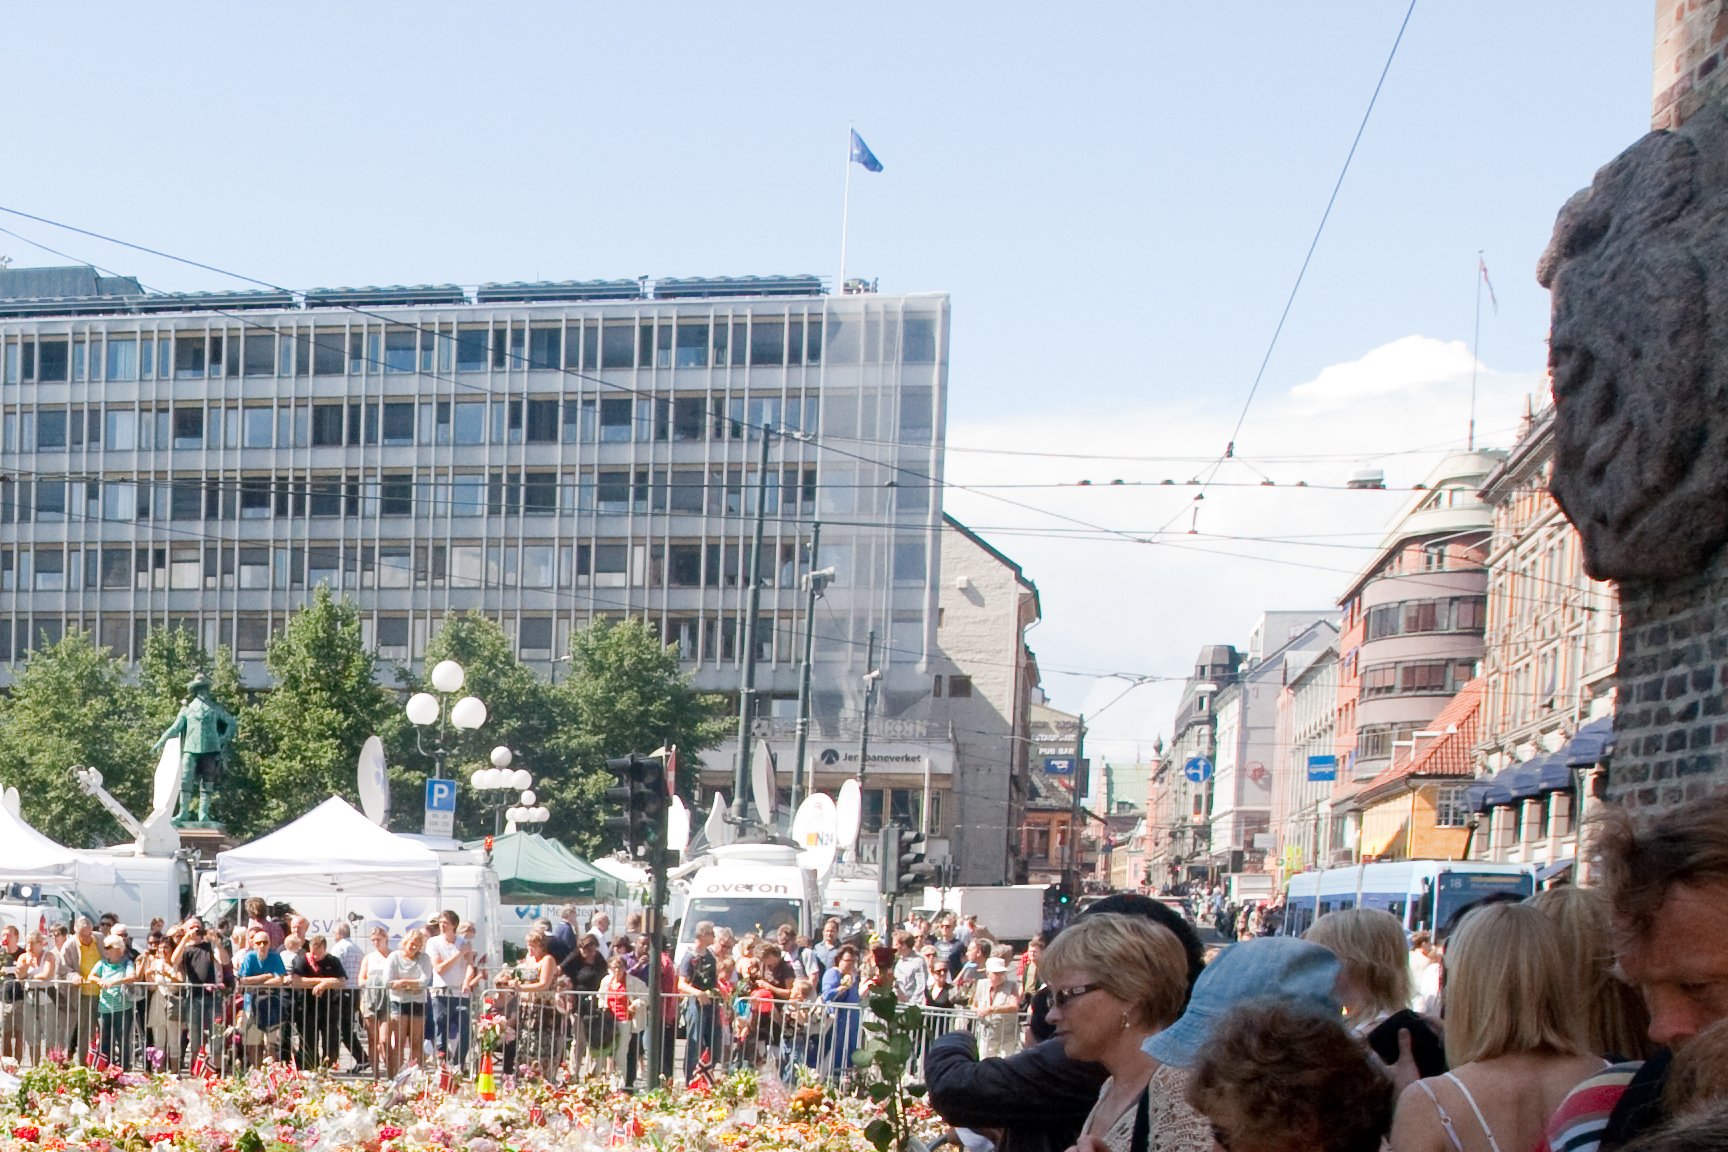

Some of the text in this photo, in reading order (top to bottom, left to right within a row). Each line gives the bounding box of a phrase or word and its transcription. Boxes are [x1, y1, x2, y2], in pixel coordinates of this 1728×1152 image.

[843, 752, 921, 763] Jerbaneverket
[433, 783, 449, 807] P
[1450, 878, 1462, 888] 18
[706, 883, 788, 895] overon
